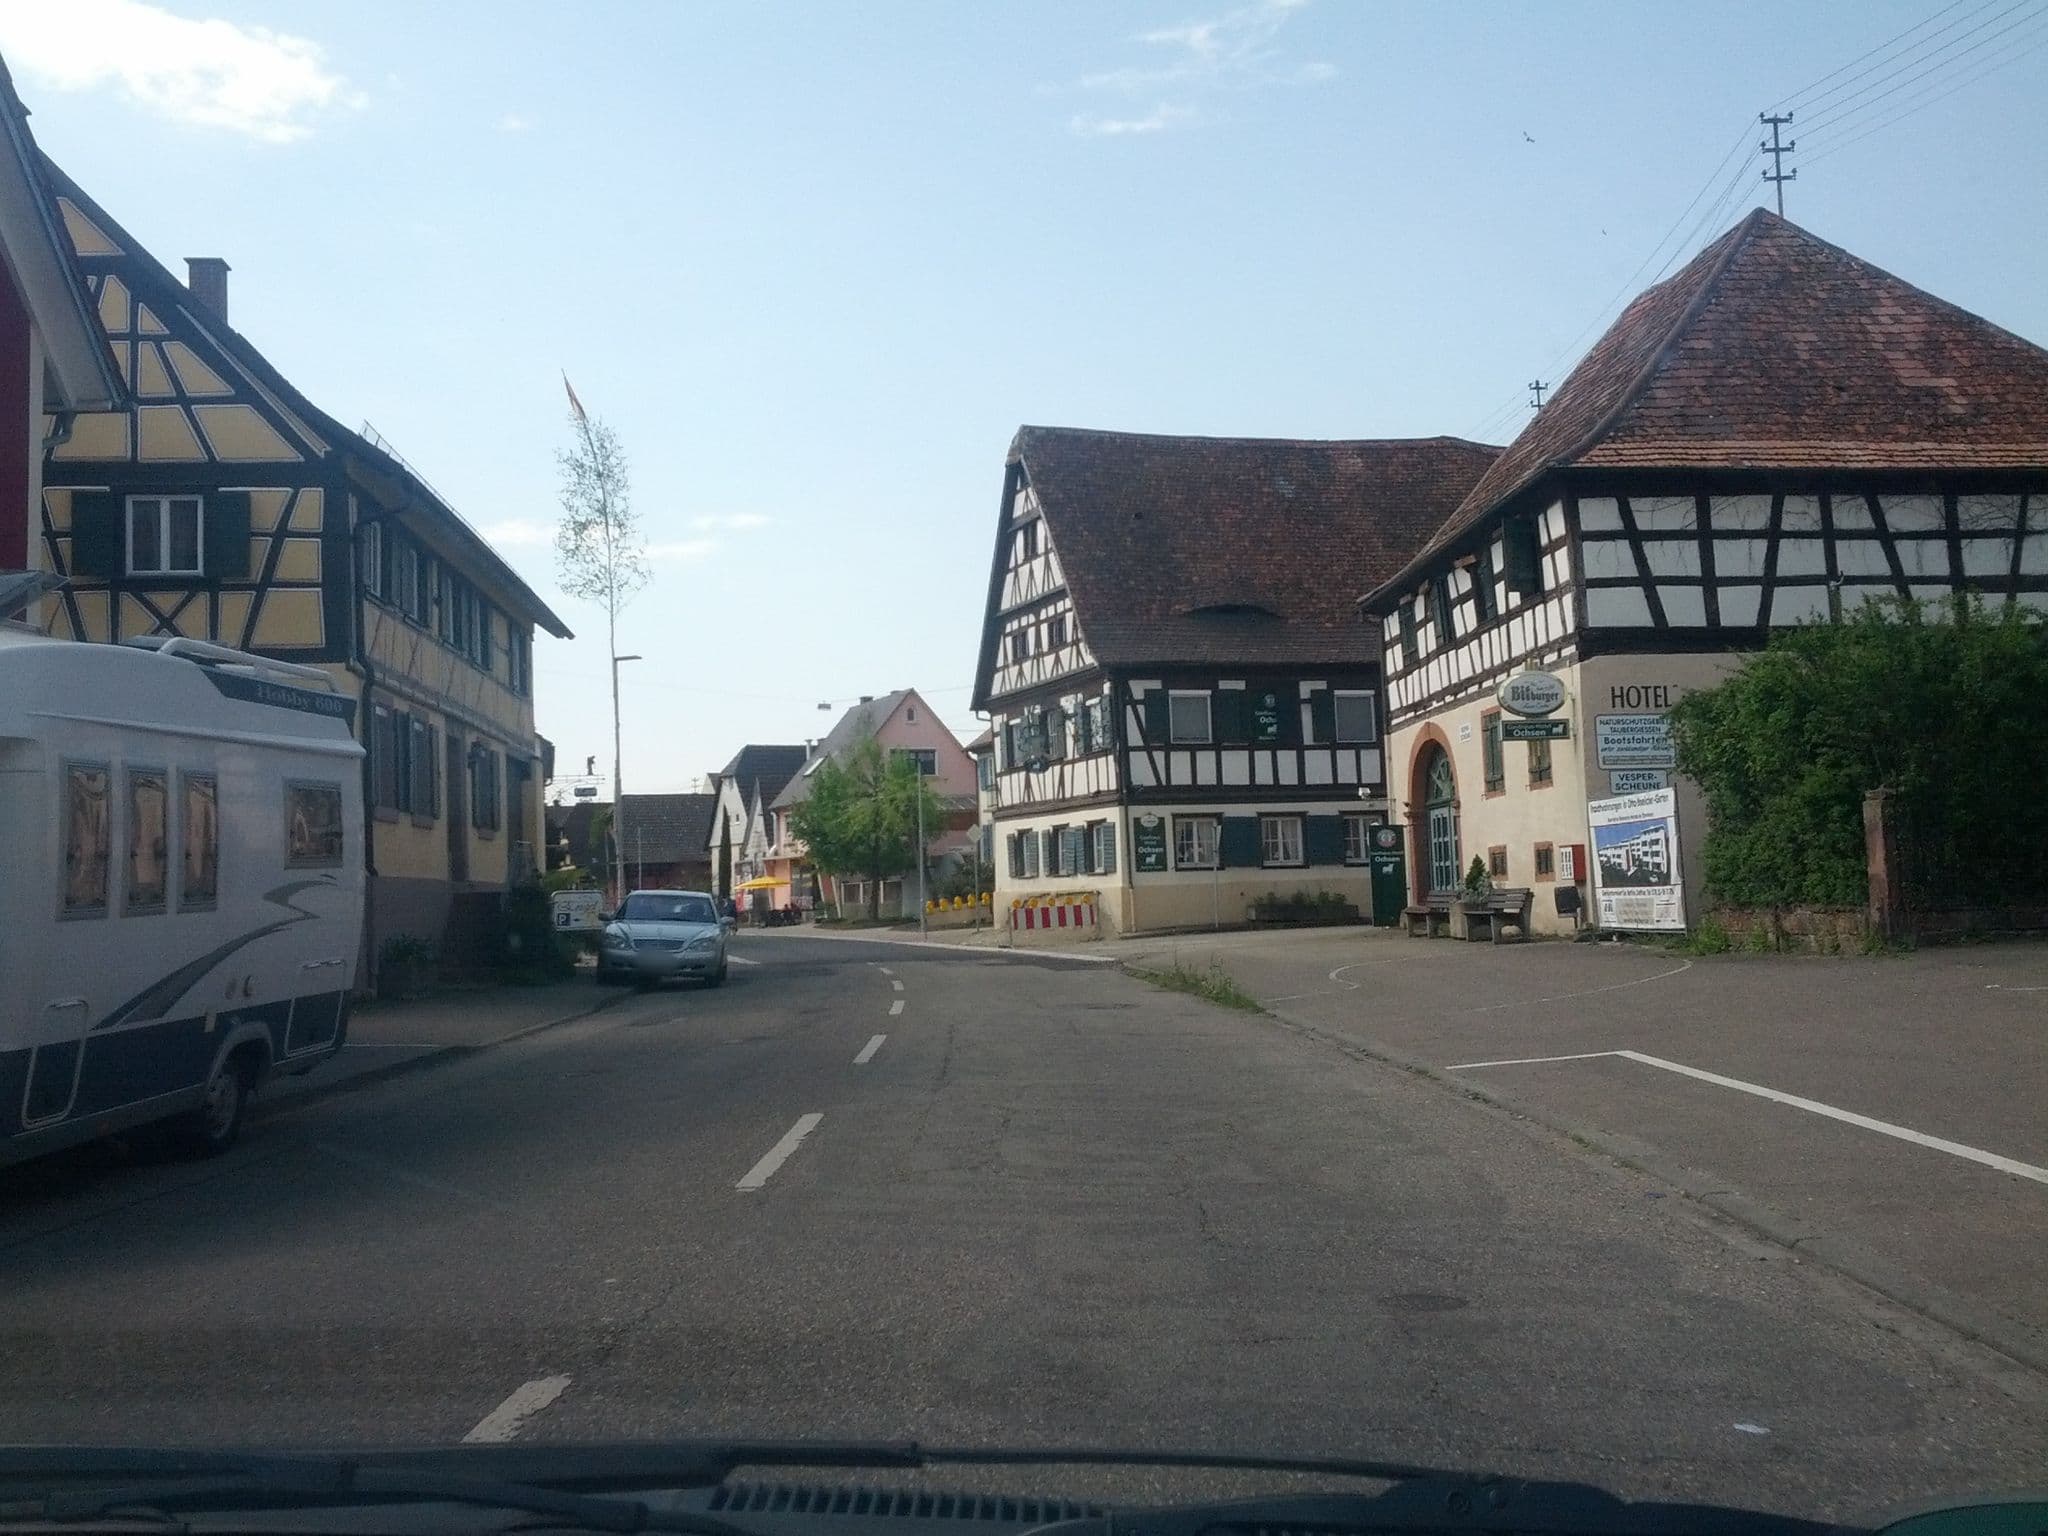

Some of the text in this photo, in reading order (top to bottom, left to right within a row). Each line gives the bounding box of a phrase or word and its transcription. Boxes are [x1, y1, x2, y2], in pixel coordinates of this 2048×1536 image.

[1511, 685, 1559, 703] Bitburger
[1610, 685, 1672, 709] HOTEL
[1513, 728, 1546, 737] Ochsen
[1604, 735, 1668, 745] Bootsfahrten
[1618, 772, 1657, 782] VESPER-
[1615, 782, 1662, 792] SCHEUNE
[1138, 846, 1164, 854] Ochsen
